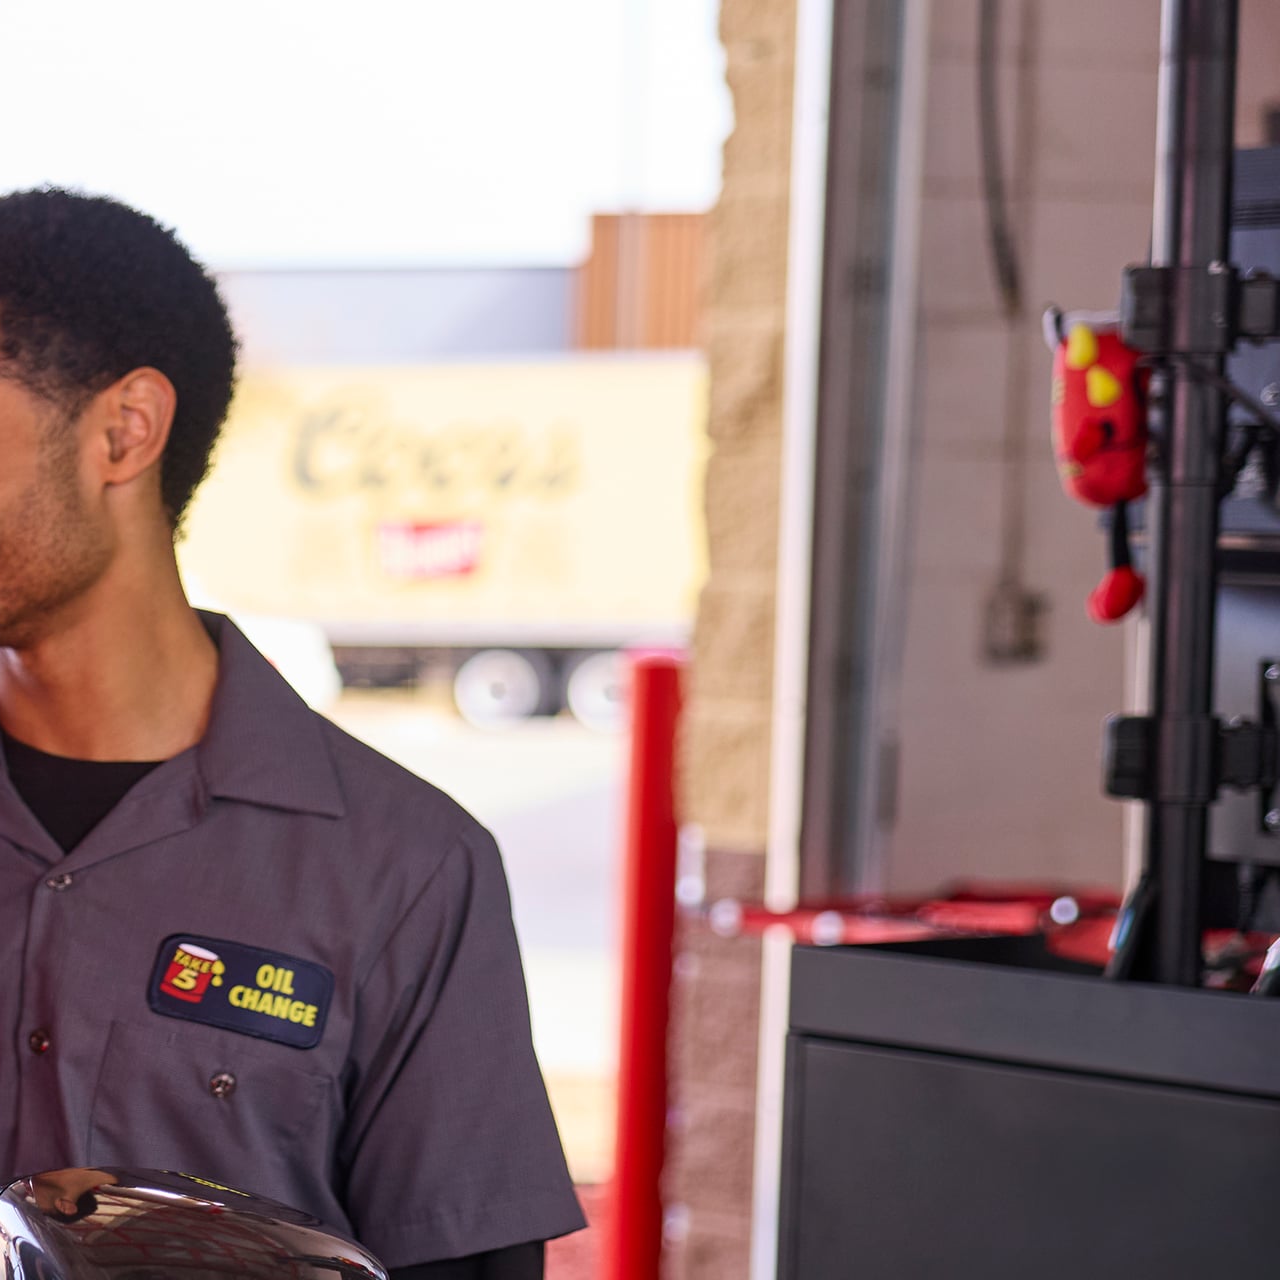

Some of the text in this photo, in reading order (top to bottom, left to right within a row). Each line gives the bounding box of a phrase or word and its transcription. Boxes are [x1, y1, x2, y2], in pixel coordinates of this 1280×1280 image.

[173, 949, 212, 974] TAKE
[171, 968, 199, 991] 5
[256, 964, 295, 995] OIL
[228, 985, 318, 1027] CHANGE
